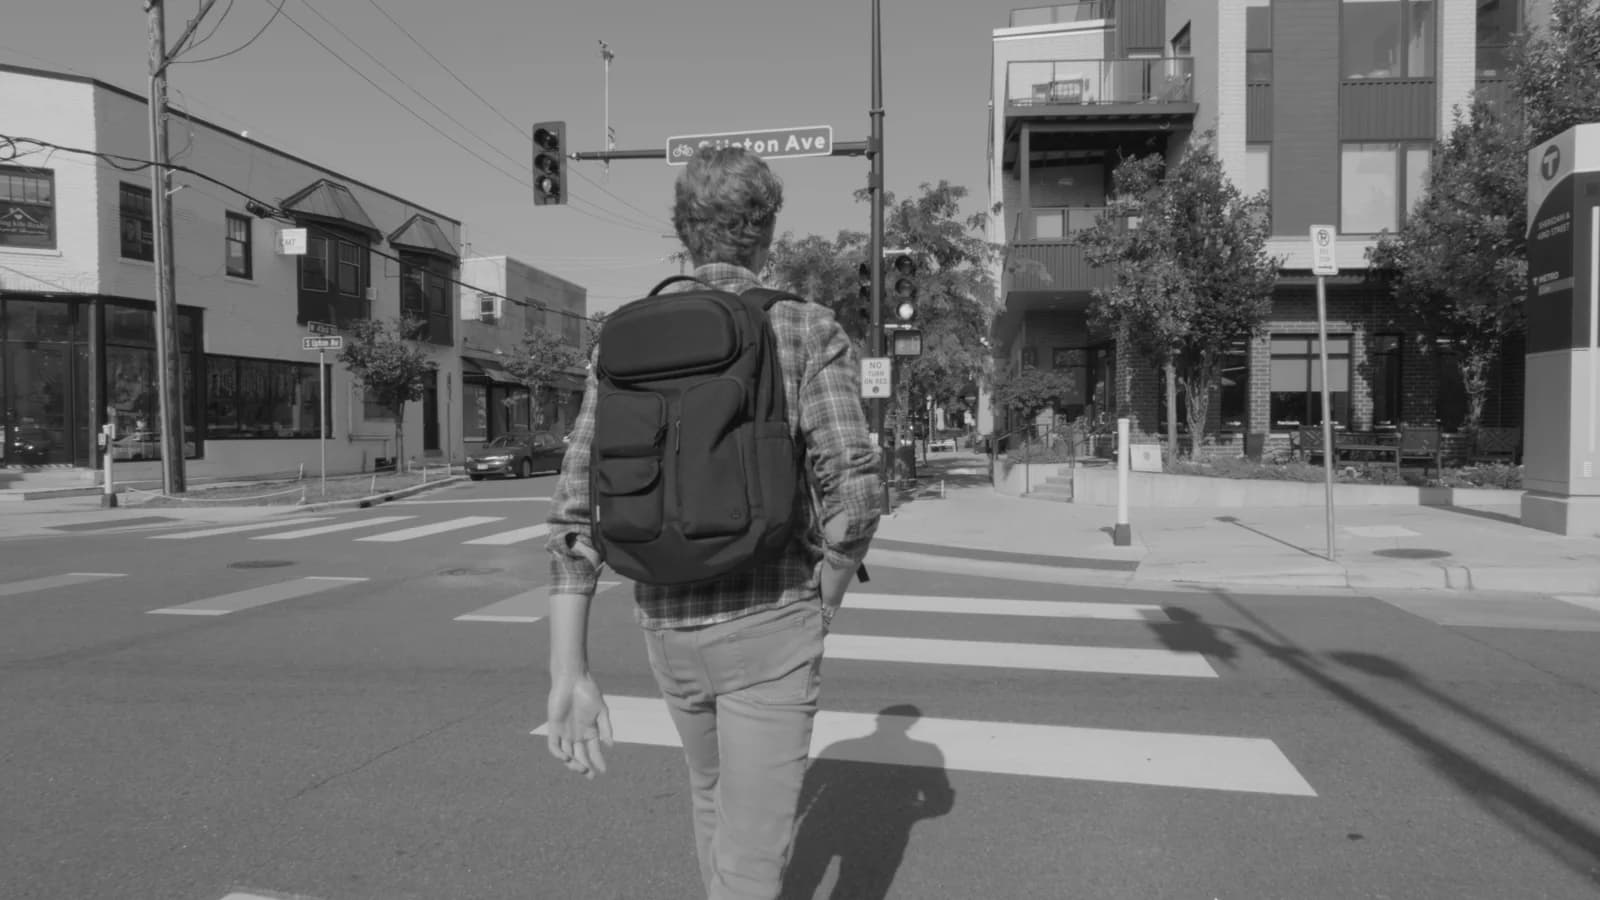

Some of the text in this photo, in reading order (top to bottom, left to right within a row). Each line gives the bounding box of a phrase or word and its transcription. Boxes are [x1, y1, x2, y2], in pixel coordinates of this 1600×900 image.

[785, 135, 825, 151] Ave
[1539, 272, 1559, 283] METRO
[869, 361, 882, 369] NO
